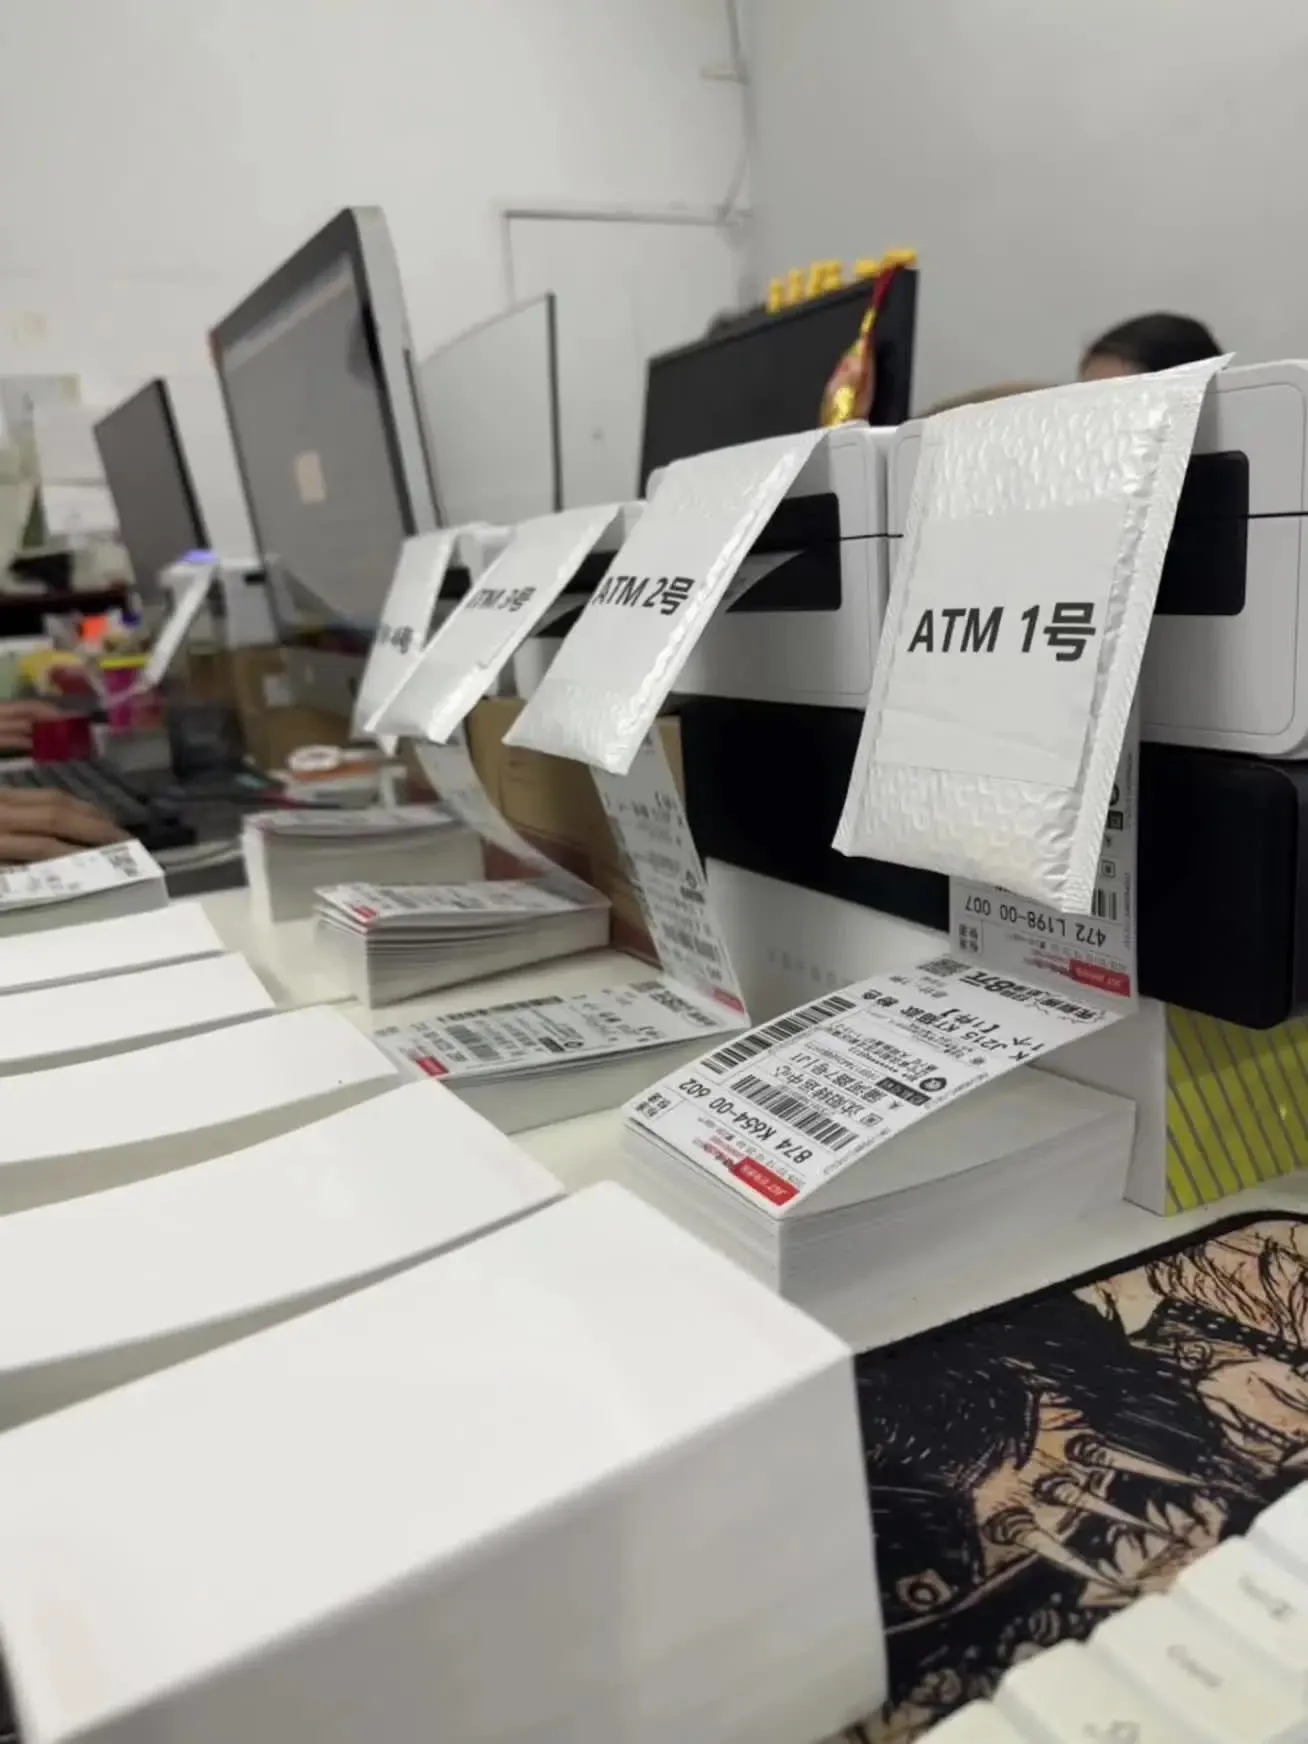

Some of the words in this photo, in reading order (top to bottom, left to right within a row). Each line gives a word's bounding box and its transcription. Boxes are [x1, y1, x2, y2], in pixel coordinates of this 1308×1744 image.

[497, 587, 537, 612] 3号
[592, 575, 650, 607] ATM
[641, 576, 696, 615] 2号
[907, 607, 1005, 653] ATM
[1020, 602, 1096, 662] 1号
[965, 895, 992, 916] 007
[1000, 903, 1066, 937] L198-00
[1075, 922, 1107, 947] 472
[862, 989, 899, 1008] 粉色
[961, 1031, 1008, 1051] J215
[1013, 1036, 1045, 1052] 1个
[1008, 1051, 1030, 1061] K
[678, 1077, 712, 1098] 602
[768, 1064, 865, 1117] 沈阳转运中心
[708, 1096, 777, 1140] K654-00
[775, 1138, 813, 1164] 874
